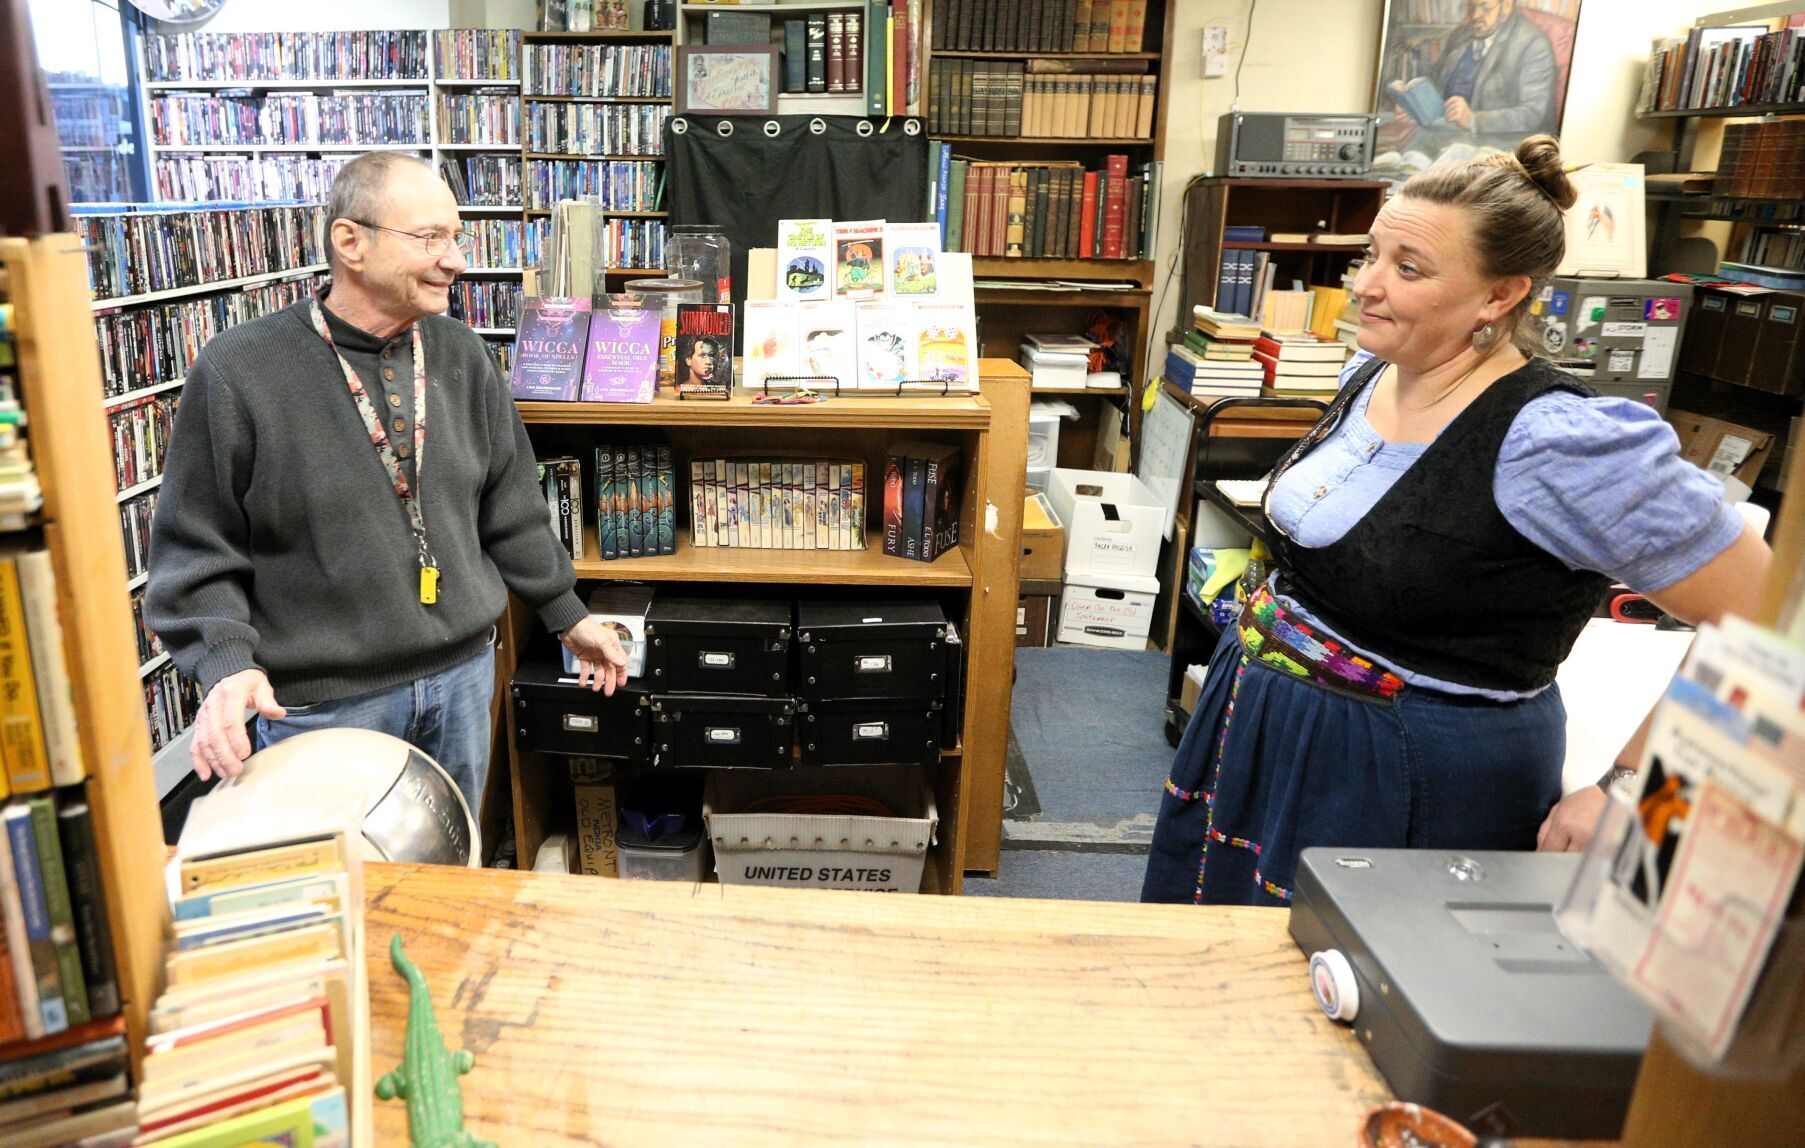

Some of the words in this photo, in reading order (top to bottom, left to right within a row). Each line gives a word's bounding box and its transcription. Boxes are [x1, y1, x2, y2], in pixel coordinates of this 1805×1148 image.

[680, 311, 732, 336] SUMMONED
[522, 340, 578, 354] WICCA
[595, 341, 651, 355] WICCA
[928, 463, 938, 485] FUSE
[561, 499, 569, 516] 100
[887, 523, 897, 553] FURY
[906, 536, 915, 557] ASHE
[935, 522, 958, 555] FUSE
[580, 799, 591, 829] OLD
[583, 834, 599, 876] EQUIP
[744, 866, 813, 881] UNITED
[817, 868, 892, 882] STATES
